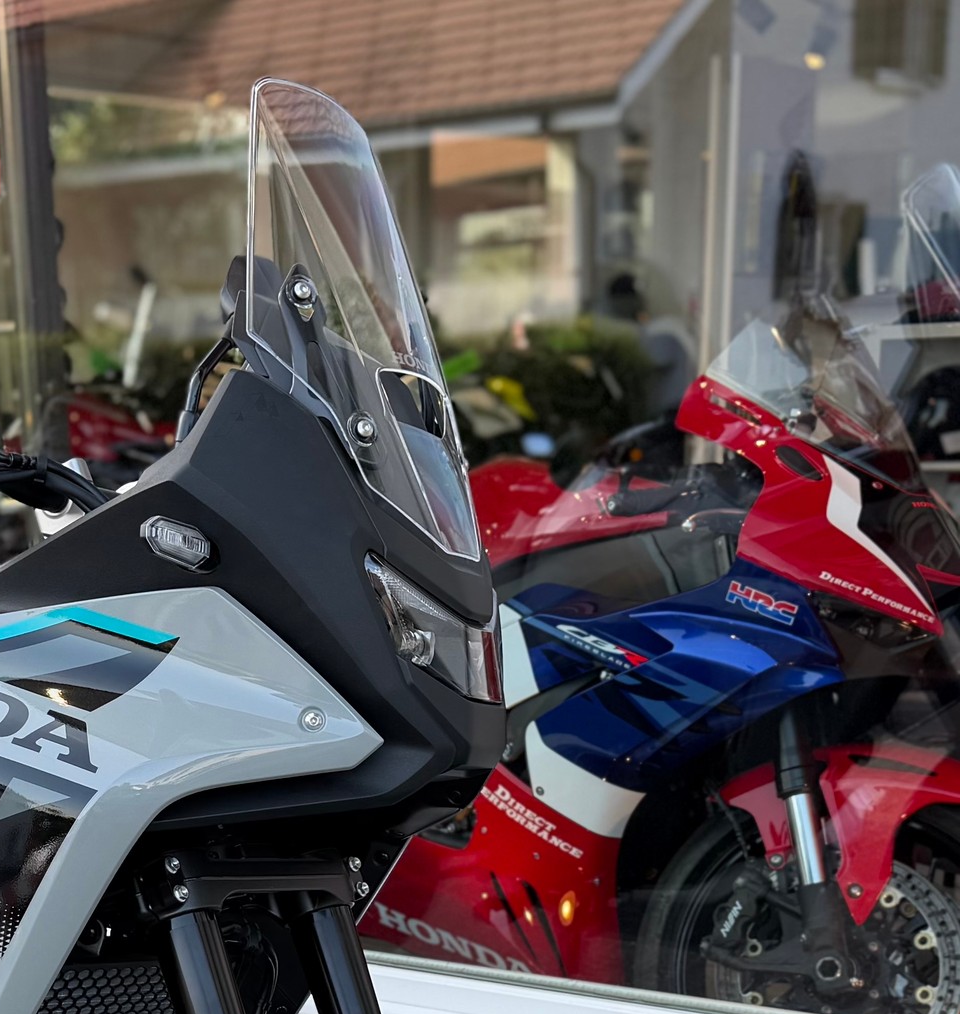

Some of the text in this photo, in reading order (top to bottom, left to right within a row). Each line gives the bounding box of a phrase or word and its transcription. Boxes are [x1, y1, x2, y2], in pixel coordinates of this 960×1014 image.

[725, 580, 799, 626] HRC
[818, 571, 936, 624] DIRECT PERFORMANCE
[480, 785, 584, 859] ERFORMANCE
[494, 784, 557, 833] DIRECT
